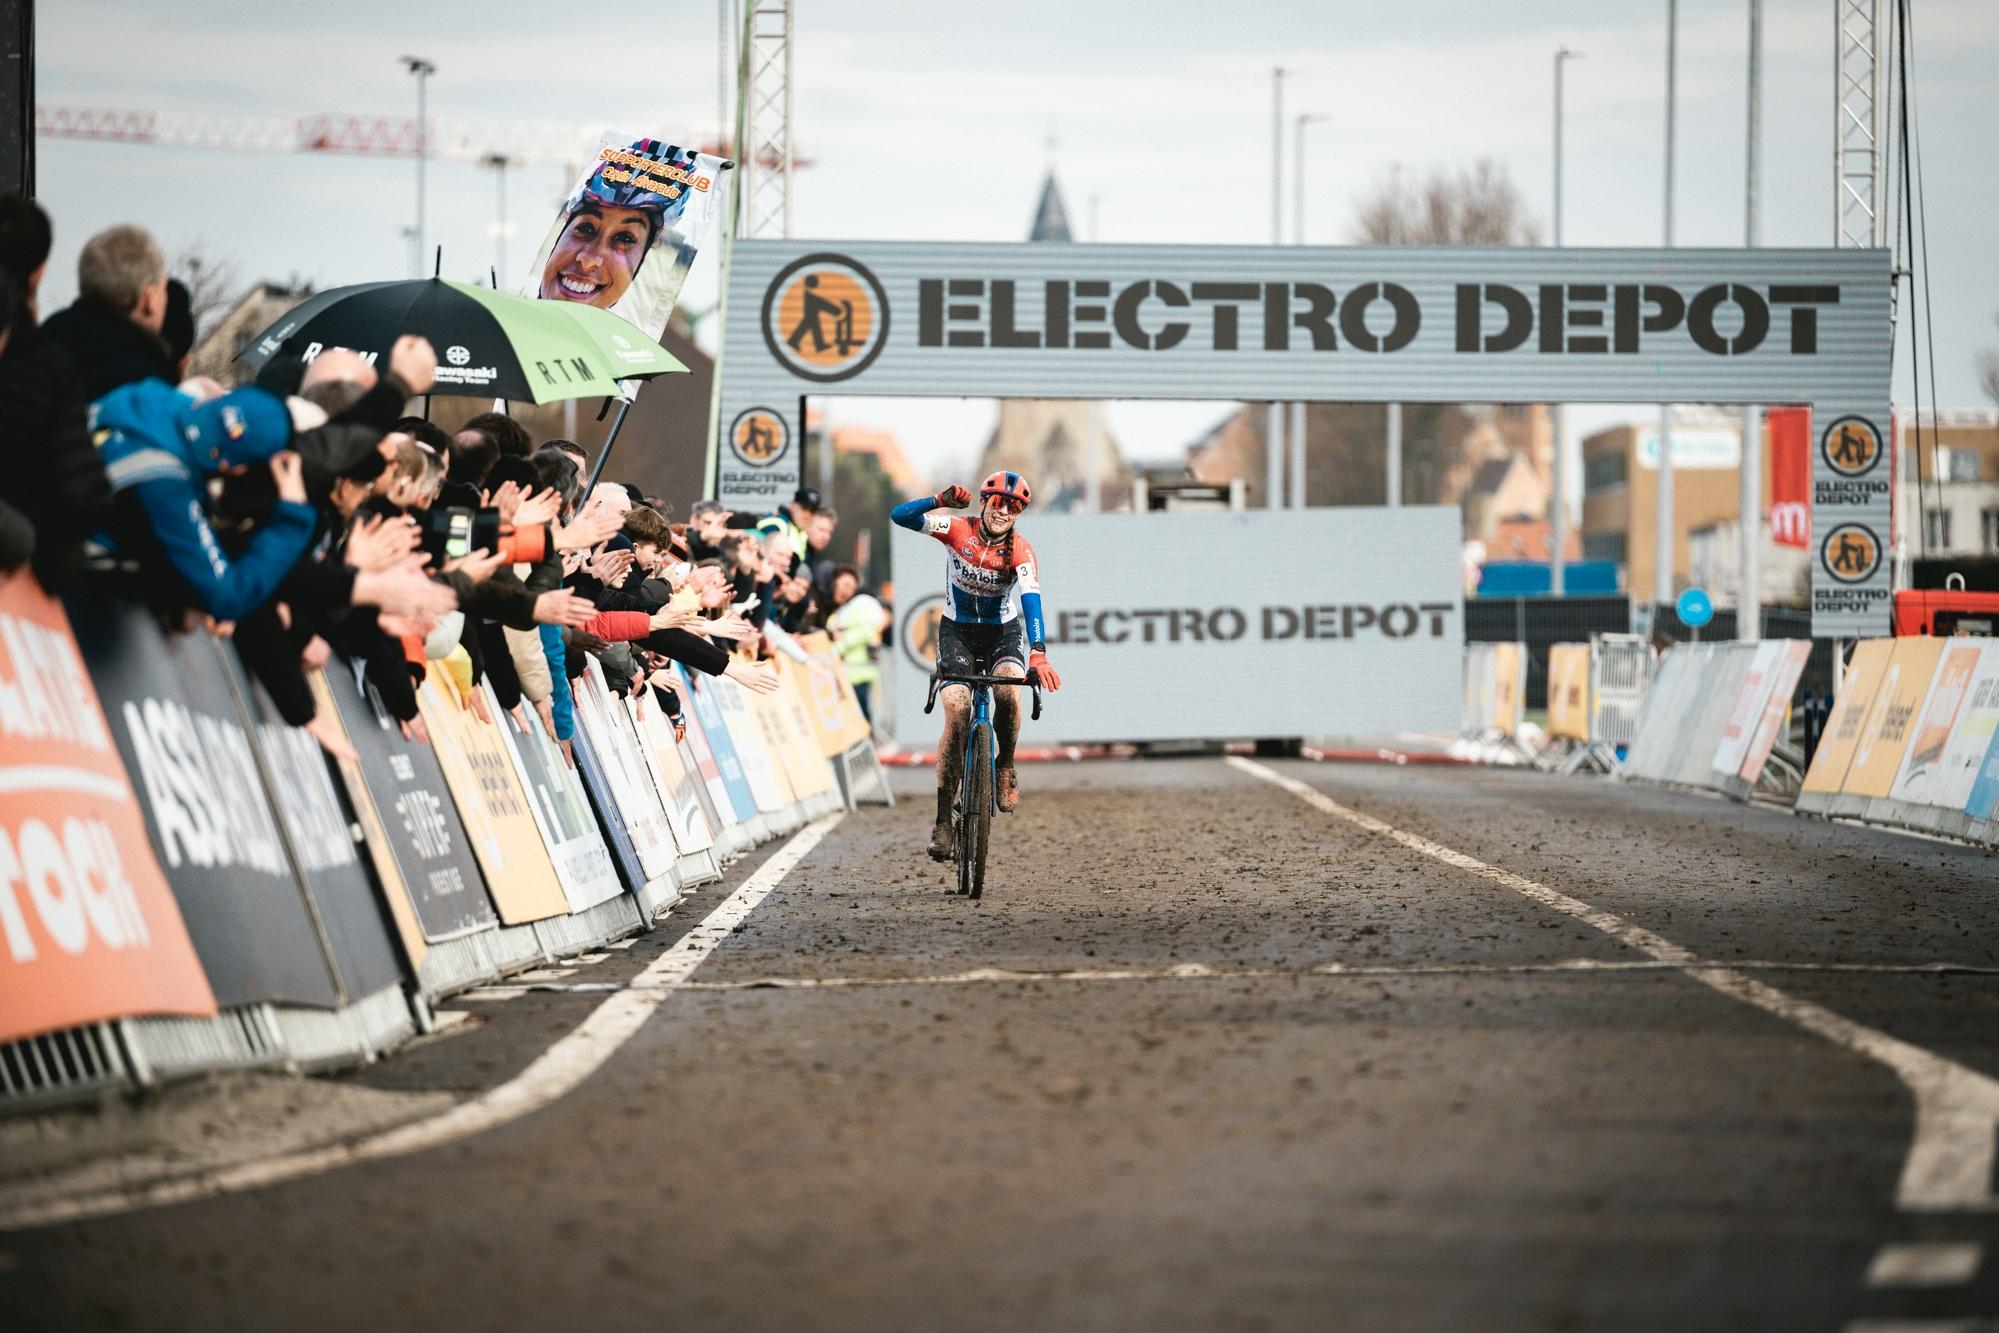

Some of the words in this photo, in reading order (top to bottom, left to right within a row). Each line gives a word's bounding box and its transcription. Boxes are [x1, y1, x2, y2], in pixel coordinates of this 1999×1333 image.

[599, 147, 711, 192] SUPPORTERCLUB
[632, 174, 681, 199] Alvarado
[918, 278, 1422, 353] ELECTRO
[1455, 283, 1840, 356] DEPOT
[433, 366, 498, 379] awasaki
[722, 473, 795, 483] ELECTRO
[722, 485, 777, 494] DEPOT
[1815, 481, 1889, 494] ELECTRO
[1815, 494, 1871, 505] DEPOT
[1020, 566, 1028, 577] 3
[1815, 588, 1889, 600] ELECTRO
[1815, 601, 1871, 613] DEPOT
[1263, 603, 1454, 640] DEPOT
